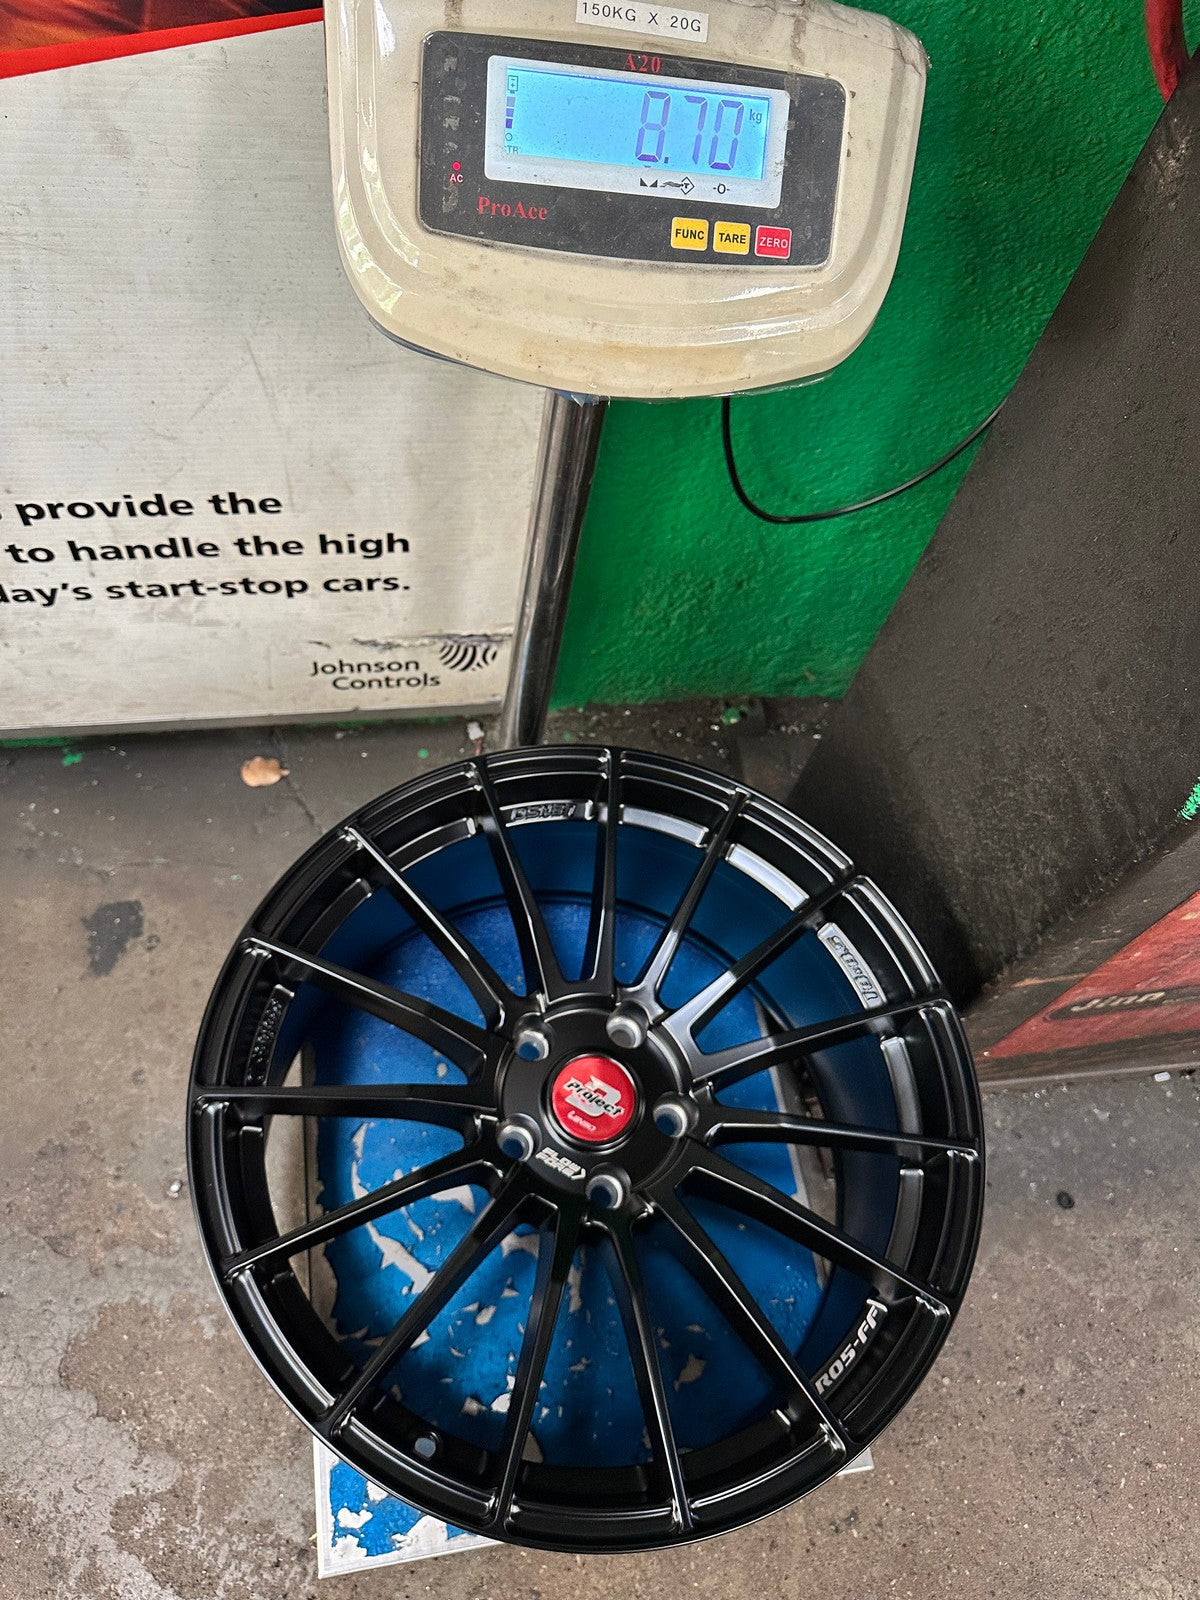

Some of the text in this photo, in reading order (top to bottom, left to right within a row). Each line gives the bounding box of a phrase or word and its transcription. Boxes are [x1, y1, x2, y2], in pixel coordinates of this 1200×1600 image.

[582, 2, 702, 33] 150KG X 20G
[622, 53, 661, 74] A20
[749, 109, 763, 124] kg
[635, 90, 745, 171] 8.70
[450, 173, 464, 183] AC
[476, 196, 549, 221] ProAce
[675, 228, 705, 241] FUNC
[719, 232, 747, 245] TARE
[759, 236, 789, 249] ZERO
[15, 492, 283, 526] provide the
[4, 533, 411, 563] to handle the high
[106, 577, 309, 600] start-stop
[322, 576, 410, 593] cars.
[310, 660, 420, 677] Johnson
[332, 673, 441, 691] Controls
[566, 1081, 622, 1116] Project
